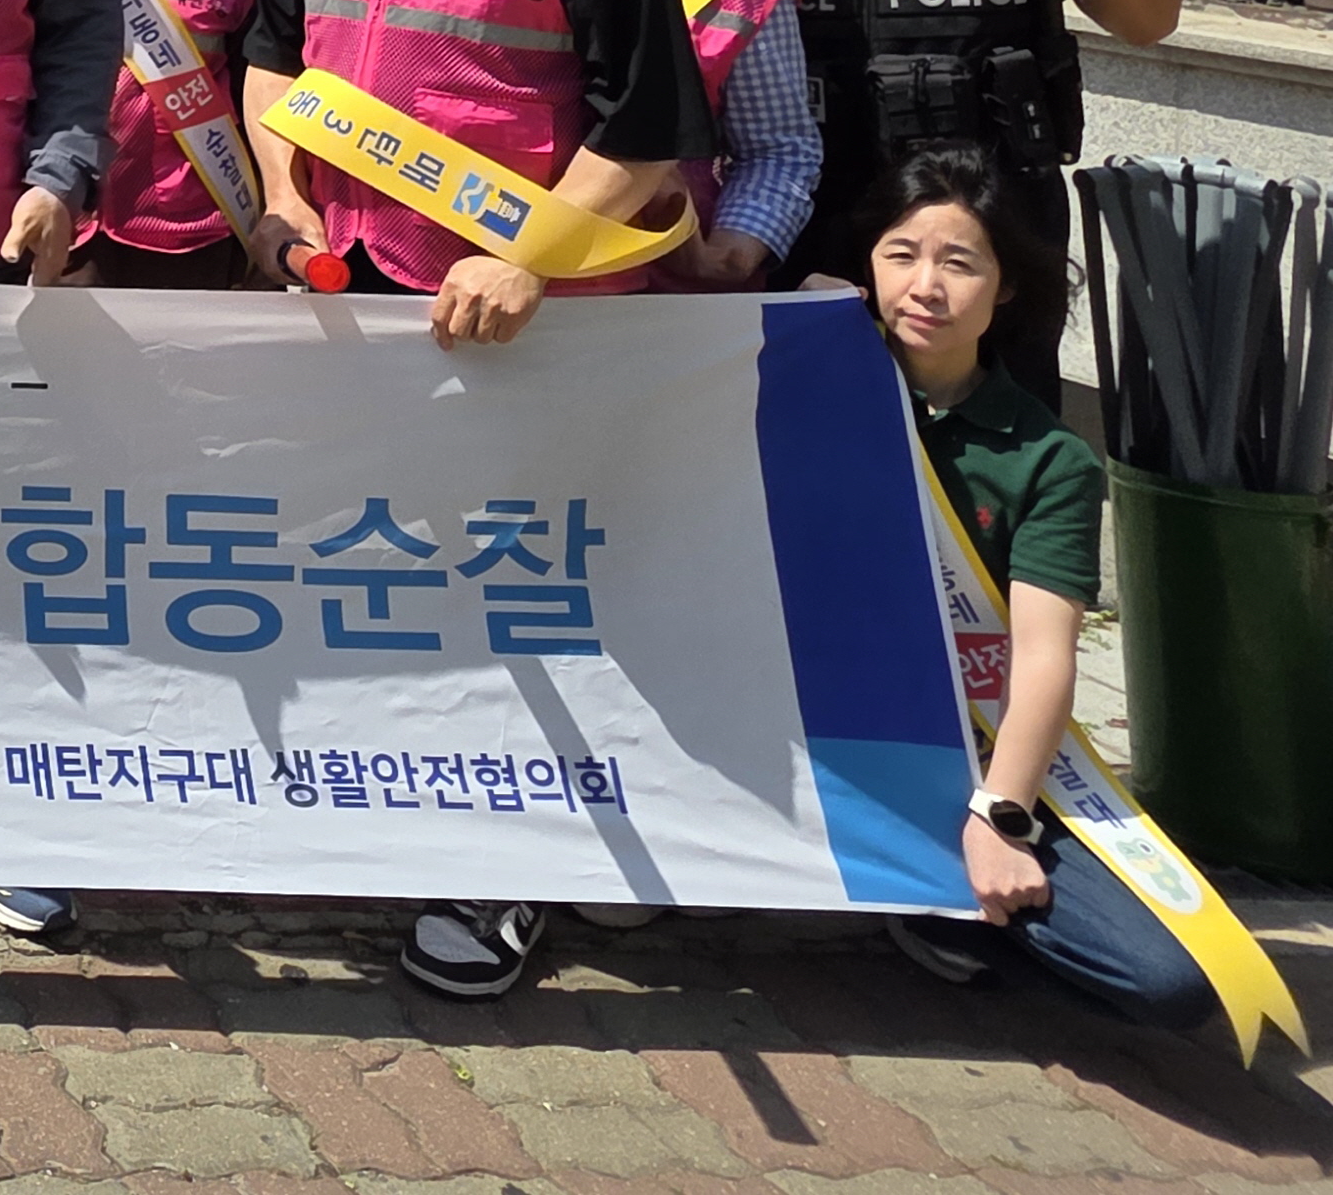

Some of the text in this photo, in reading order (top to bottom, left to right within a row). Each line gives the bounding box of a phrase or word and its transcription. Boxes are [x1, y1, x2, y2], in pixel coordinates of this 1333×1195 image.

[165, 74, 214, 120] 안전
[288, 90, 446, 193] 매탄3동
[0, 485, 607, 657] 합동순찰
[3, 742, 629, 817] 매탄지구대 생활안전협의회
